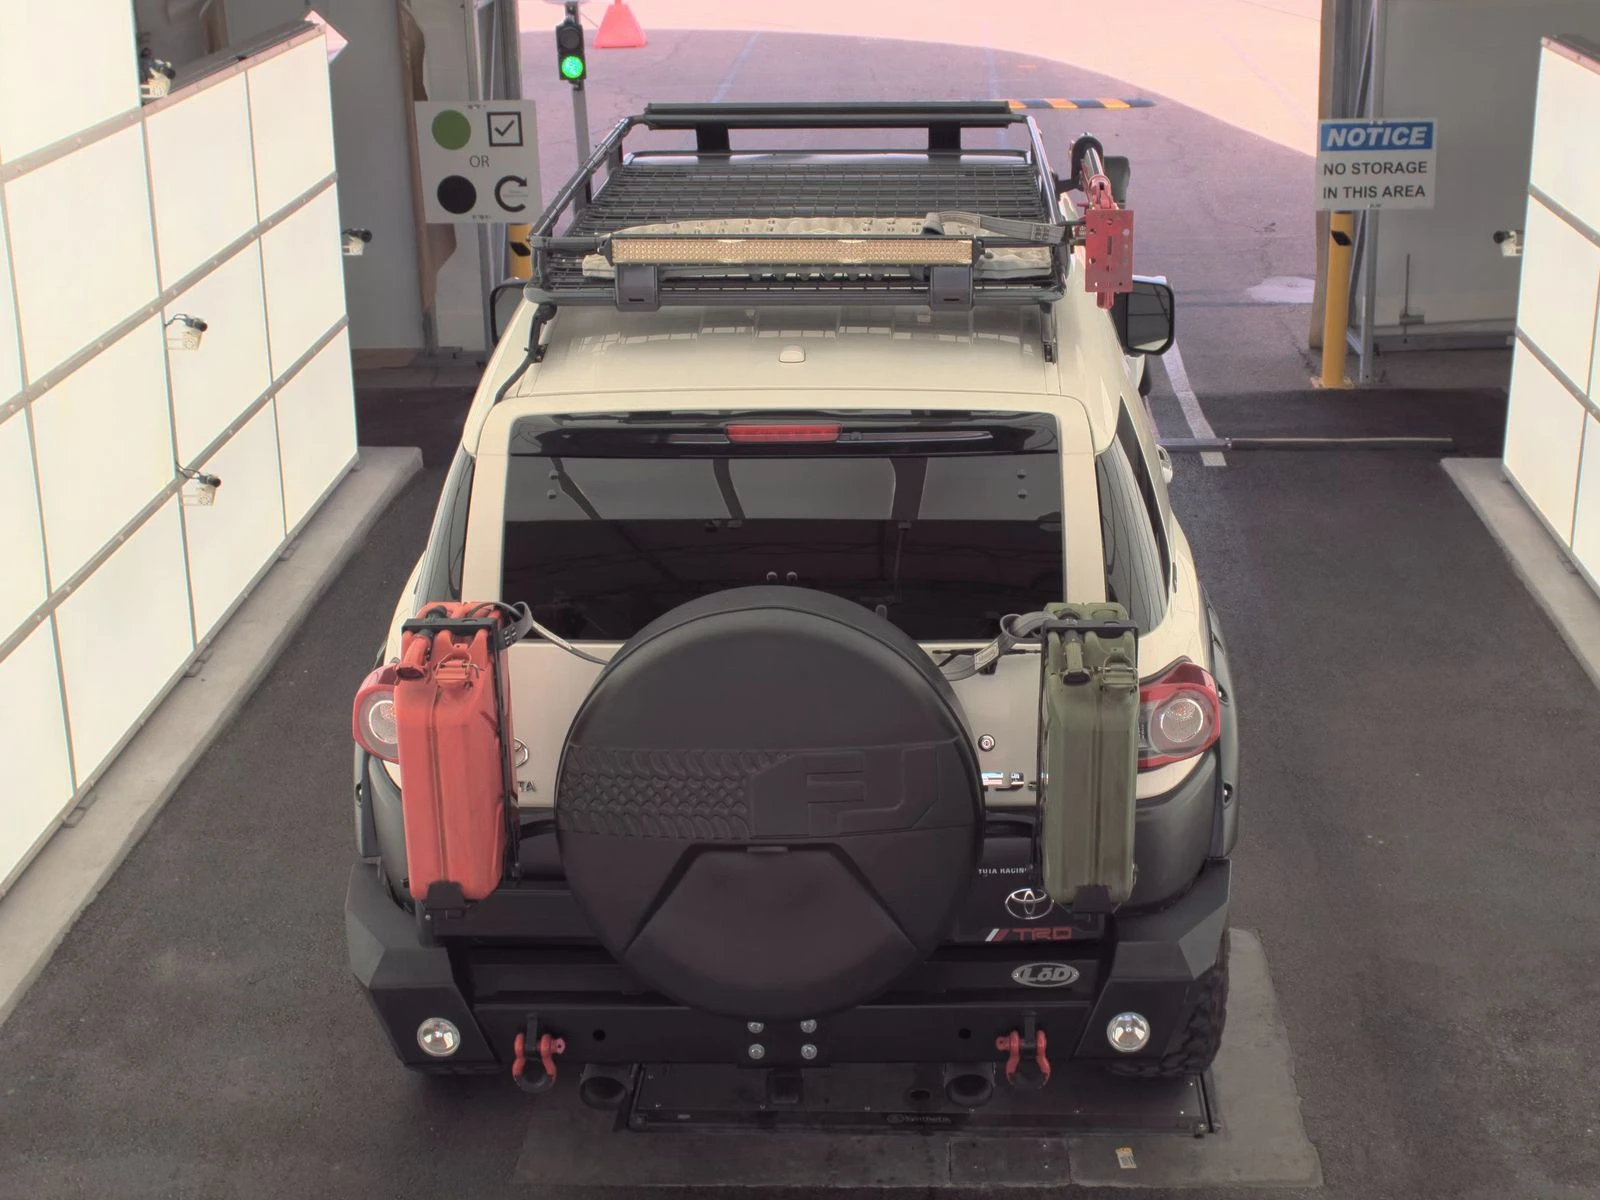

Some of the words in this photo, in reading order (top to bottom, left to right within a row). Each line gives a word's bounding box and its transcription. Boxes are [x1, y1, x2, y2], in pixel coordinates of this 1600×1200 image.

[1326, 126, 1428, 147] NOTICE
[469, 154, 490, 168] OR
[1323, 162, 1346, 176] NO
[1351, 161, 1428, 175] STORAGE
[1323, 187, 1338, 199] IN
[1343, 185, 1378, 199] THIS
[1382, 184, 1426, 198] AREA
[1012, 927, 1072, 941] TRD
